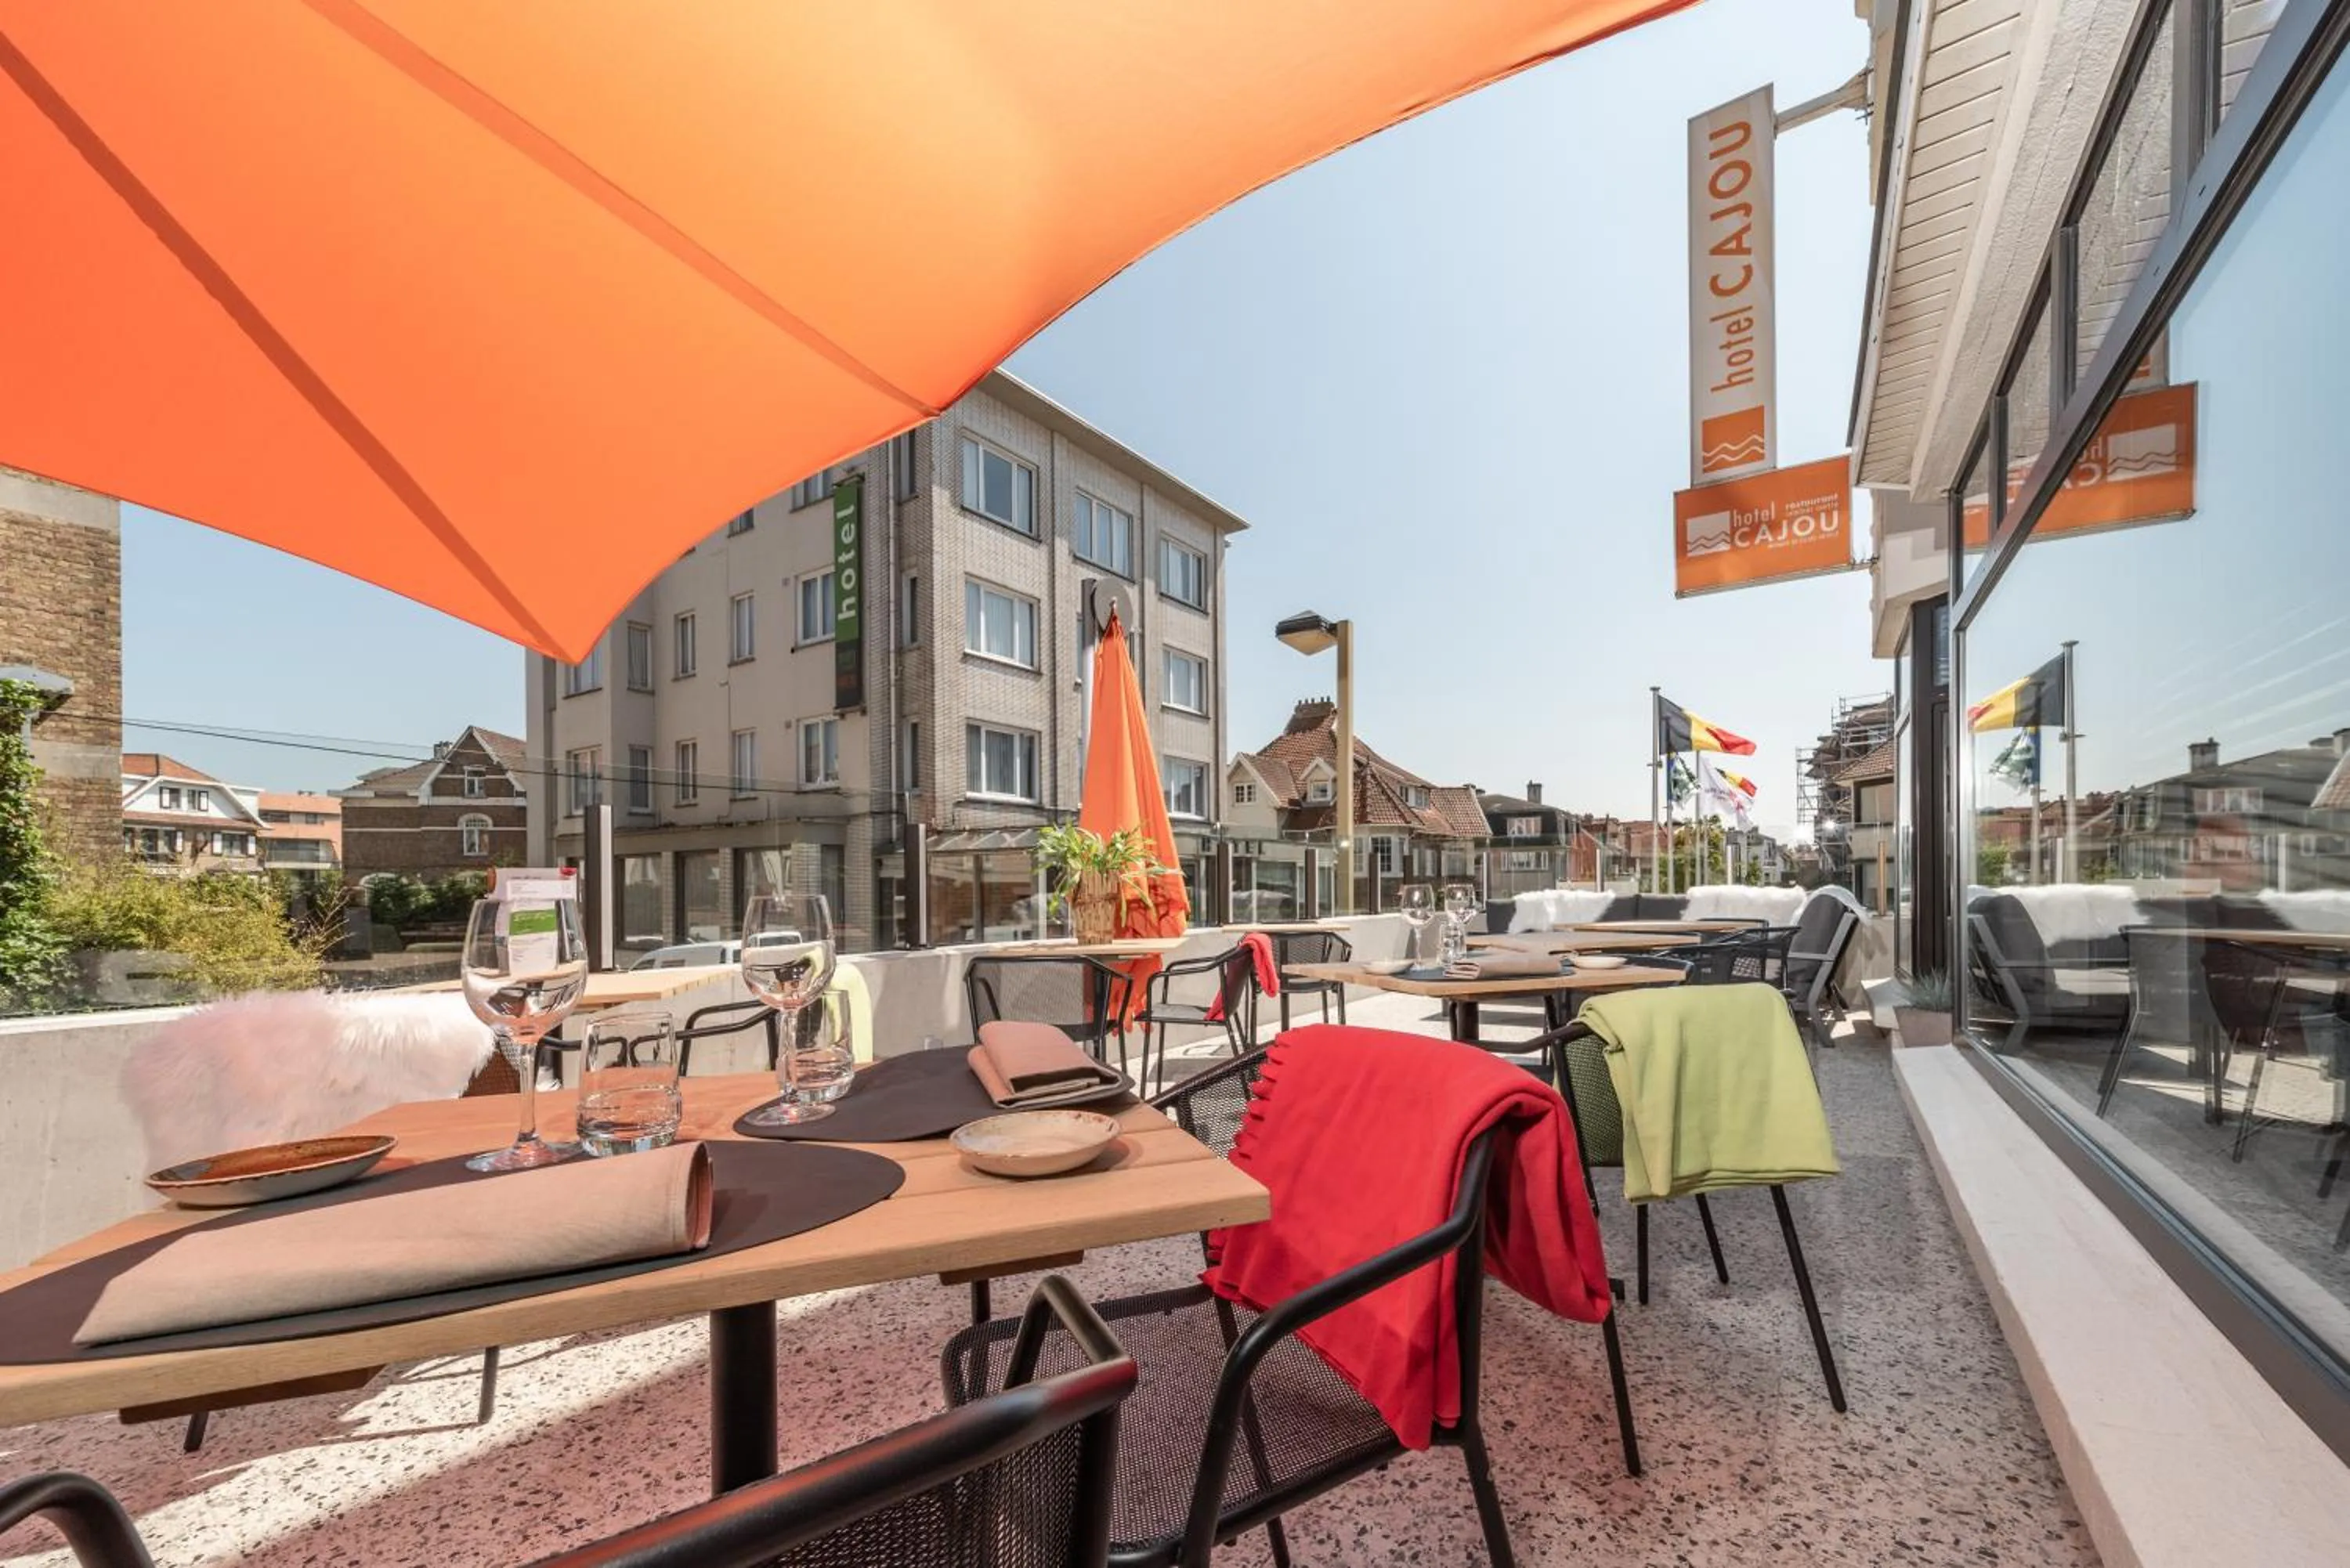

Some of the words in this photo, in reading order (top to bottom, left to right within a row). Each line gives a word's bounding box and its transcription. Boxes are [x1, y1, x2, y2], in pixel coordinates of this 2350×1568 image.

[1708, 121, 1753, 297] CAJOU
[1710, 305, 1754, 392] hotel
[1734, 500, 1776, 527] hotel
[1734, 510, 1839, 548] CAJOU
[837, 504, 856, 621] hotel
[1201, 836, 1266, 856] HTEL
